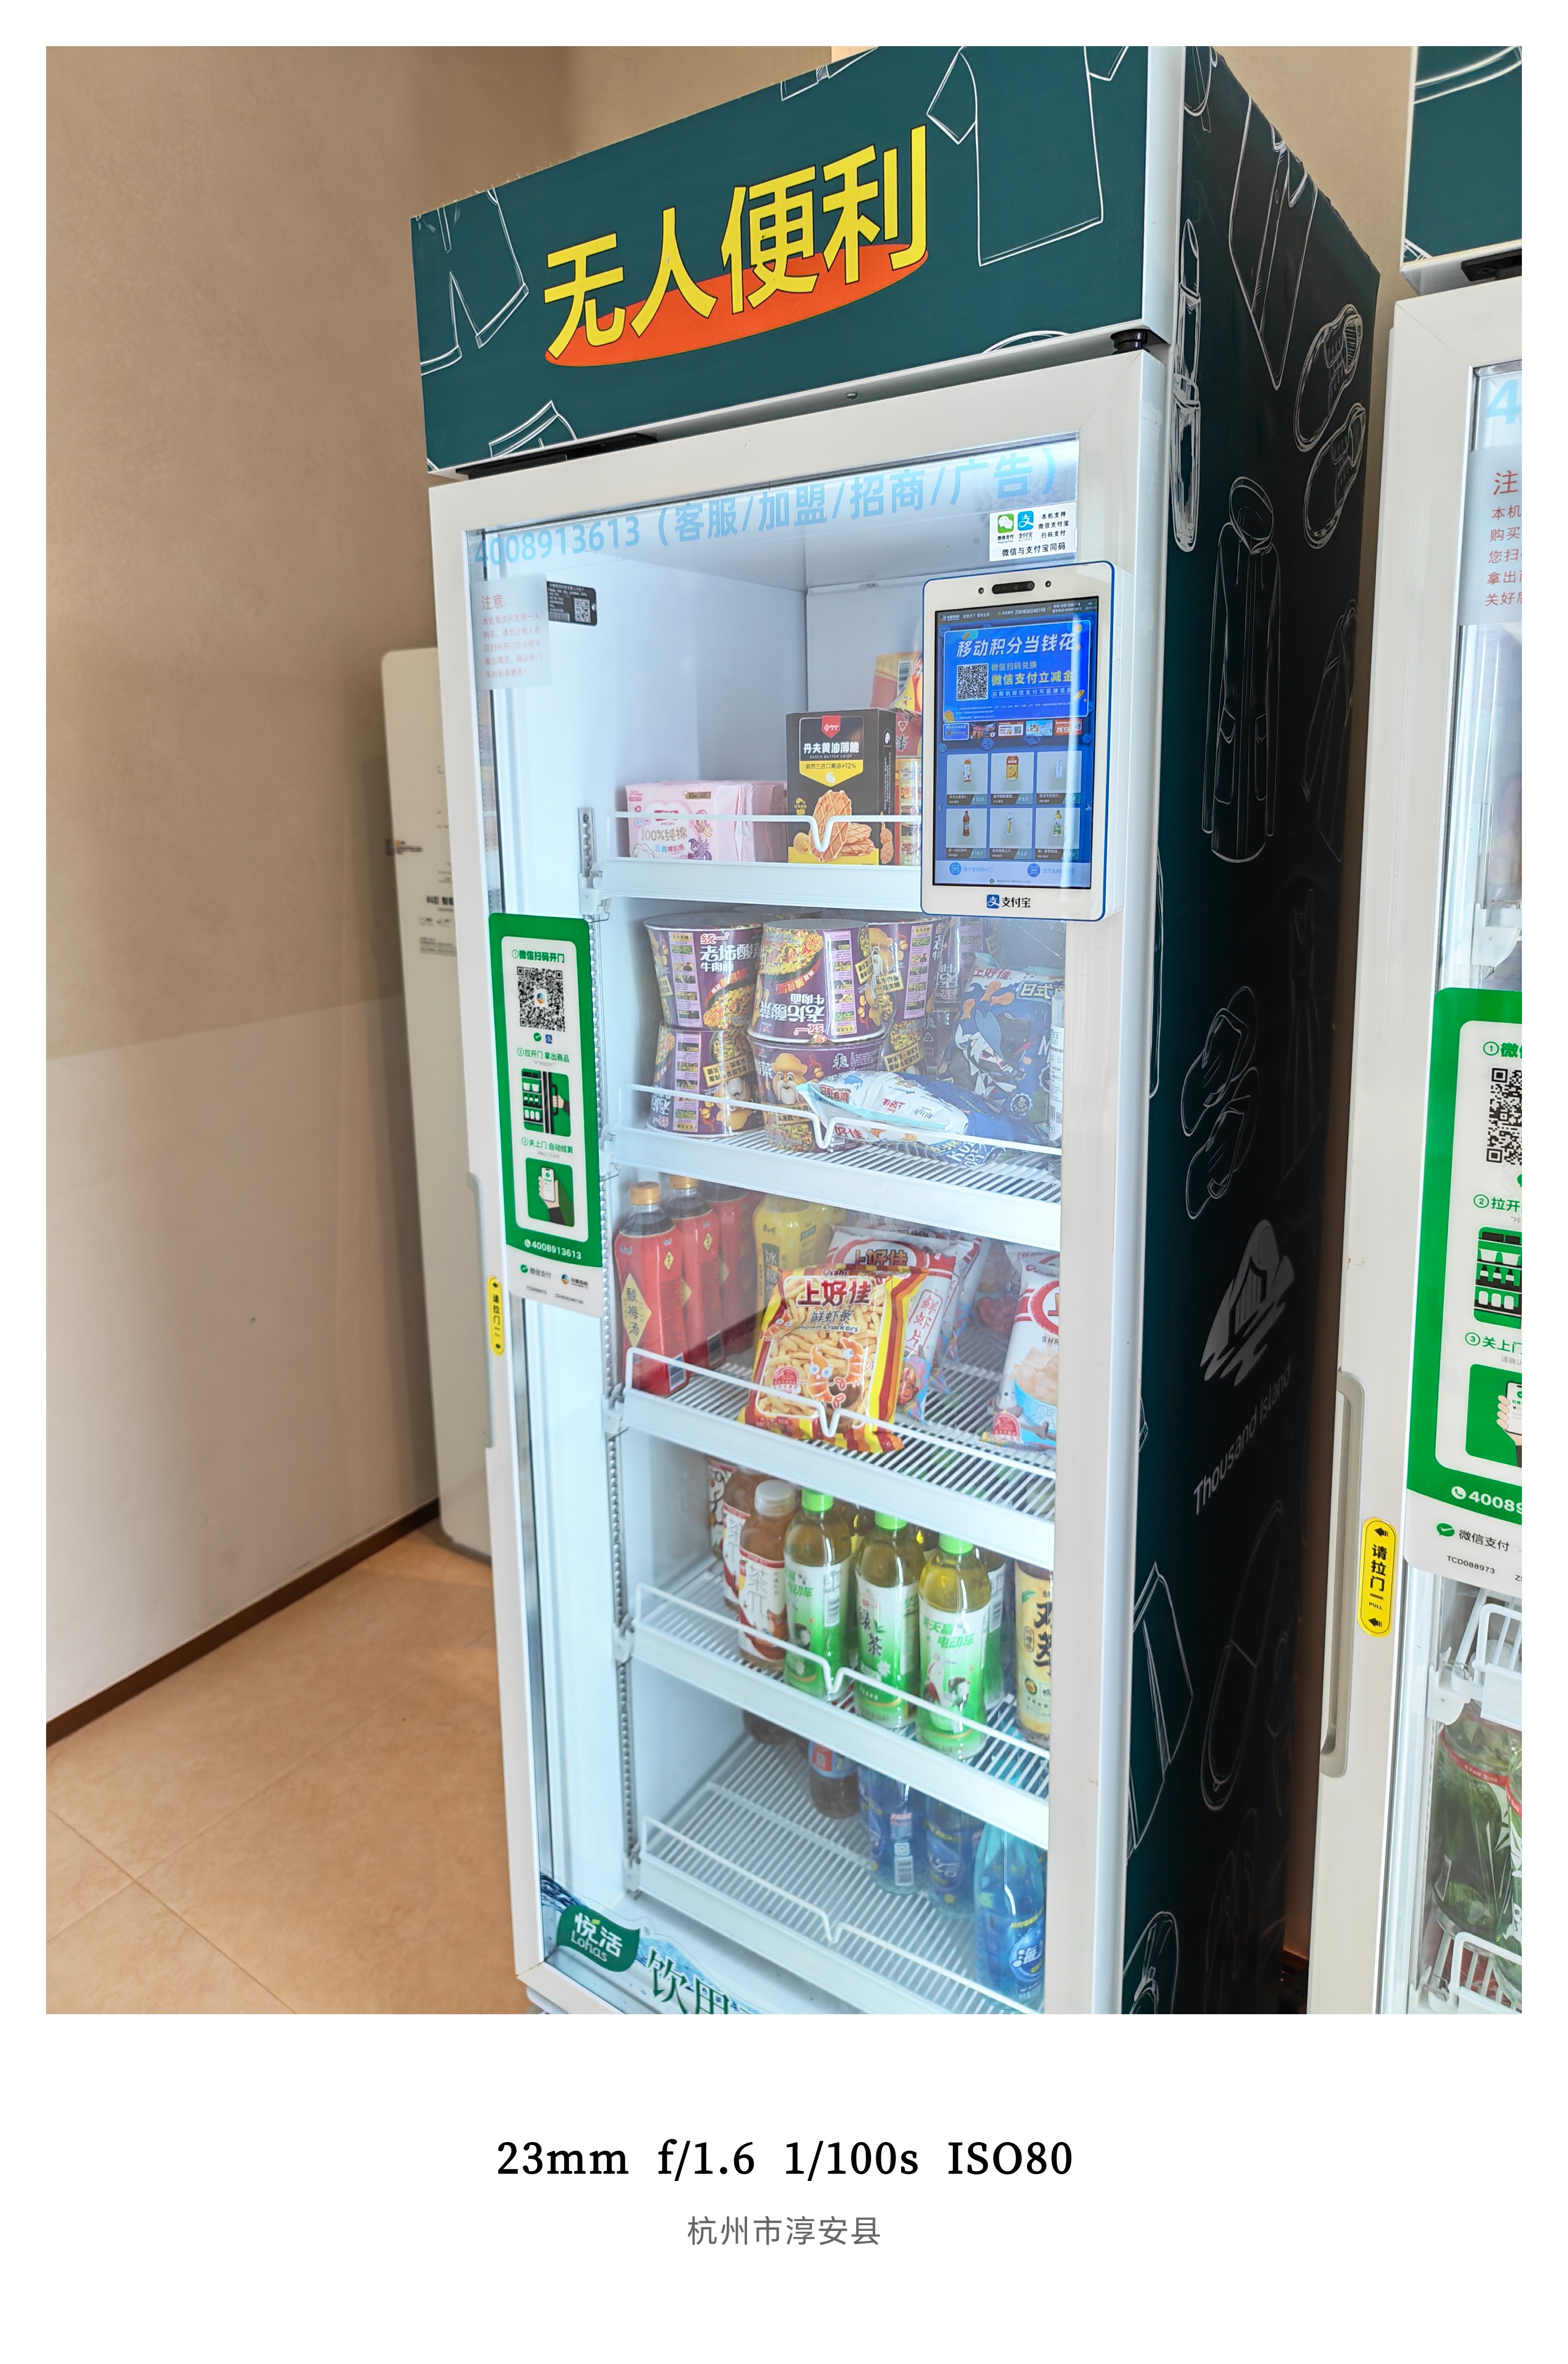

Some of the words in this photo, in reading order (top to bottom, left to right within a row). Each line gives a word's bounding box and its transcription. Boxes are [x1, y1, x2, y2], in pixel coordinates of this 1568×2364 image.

[545, 124, 927, 359] 无人便利
[1493, 470, 1522, 496] 注
[1041, 511, 1066, 520] 本机支持
[1491, 505, 1522, 521] 本机
[1038, 520, 1069, 529] 微信支付宝
[1041, 530, 1066, 539] 扫码支付
[1489, 526, 1521, 542] 购买
[1002, 542, 1065, 557] 微信与支付宝同码
[1488, 548, 1522, 564] 您扫
[1486, 570, 1522, 586] 拿出
[956, 633, 1077, 658] 移动积分当钱花
[992, 670, 1073, 686] 微信支付立减金
[804, 741, 859, 754] 丹夫黄油薄脆
[641, 826, 687, 841] 100%纯棉
[1001, 897, 1031, 909] 支付宝
[700, 934, 727, 945] 统一
[700, 961, 734, 973] 牛肉面
[791, 994, 825, 1005] 牛肉面
[760, 1001, 825, 1022] 老坛酸菜
[545, 1052, 570, 1063] 拿出商品
[1483, 1041, 1522, 1059] ①微
[834, 1125, 863, 1139] 好佳
[549, 1143, 573, 1154] 自动结算
[1473, 1194, 1522, 1213] ②拉开
[532, 1242, 581, 1260] 4008913613
[855, 1249, 908, 1267] 上好佳
[797, 1280, 871, 1306] 上好佳
[626, 1287, 639, 1336] 酸梅汤
[811, 1309, 853, 1323] 鲜虾条
[823, 1324, 858, 1332] Crackers
[906, 1295, 938, 1348] 鲜虾片
[1193, 1413, 1257, 1515] Thousand
[1260, 1358, 1292, 1424] Island
[1458, 1529, 1509, 1551] 微信支付
[1370, 1544, 1387, 1591] 请拉门
[1446, 1555, 1495, 1574] TCD088973
[575, 1912, 623, 1958] 悦活
[571, 1930, 608, 1963] Lohas
